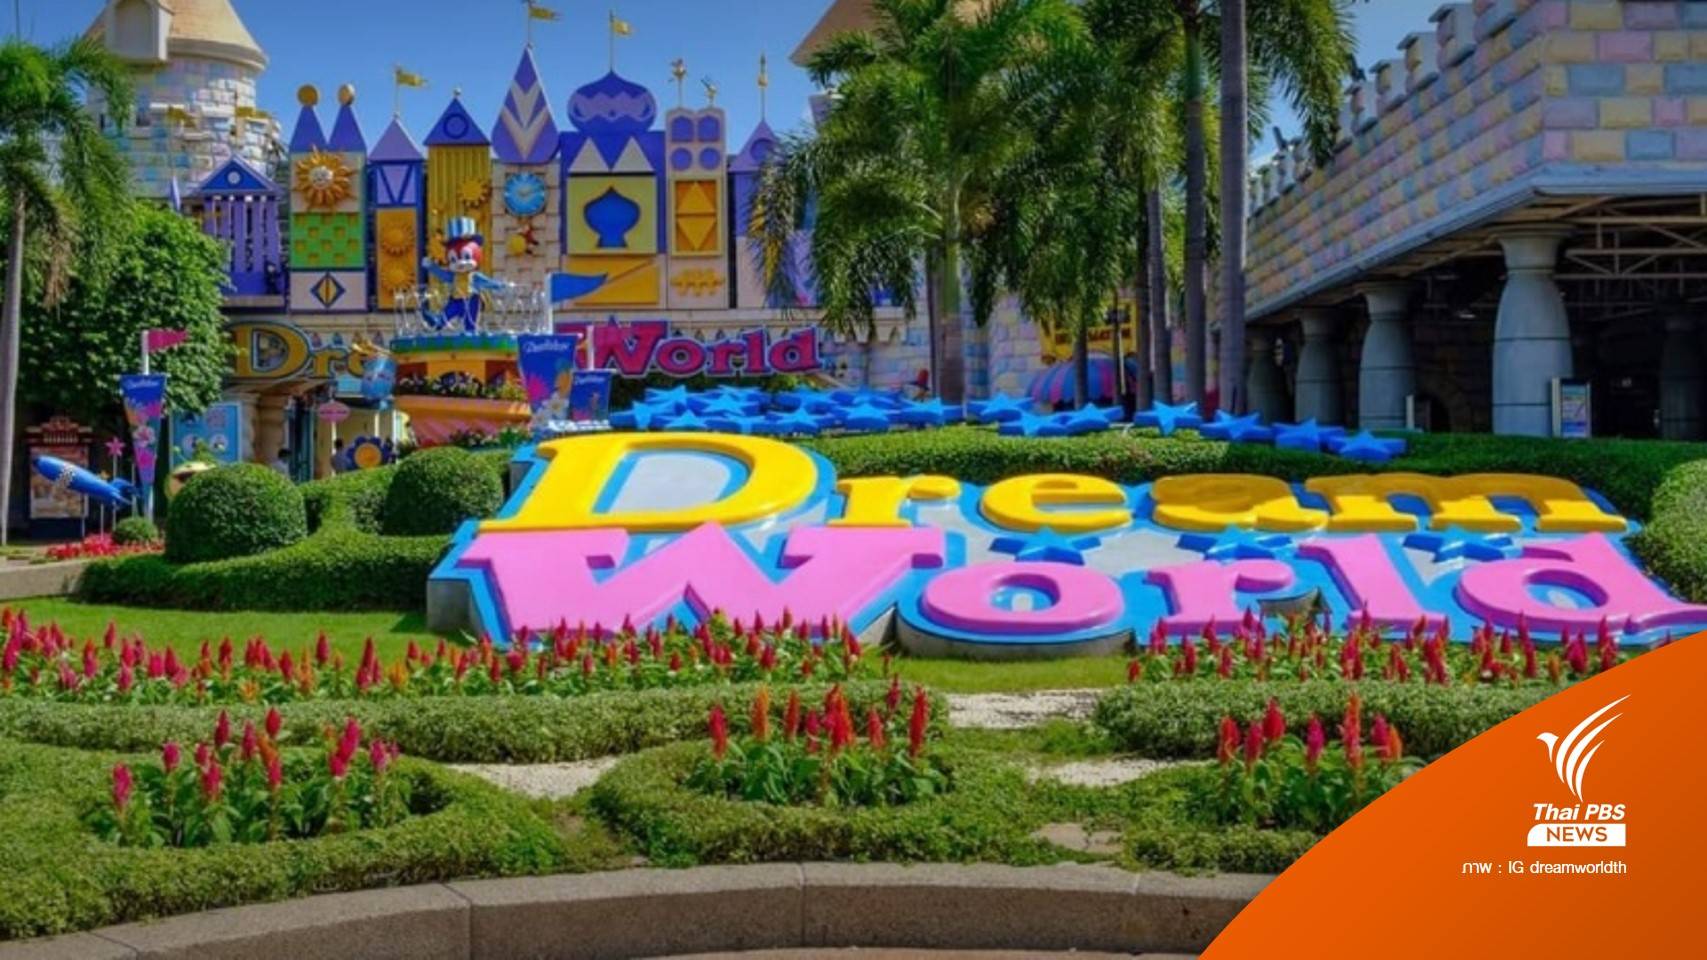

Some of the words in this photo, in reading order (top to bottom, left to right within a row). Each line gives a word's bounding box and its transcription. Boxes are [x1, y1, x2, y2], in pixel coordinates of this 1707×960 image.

[554, 320, 821, 376] World
[479, 431, 1627, 532] Dream
[456, 521, 1707, 634] World
